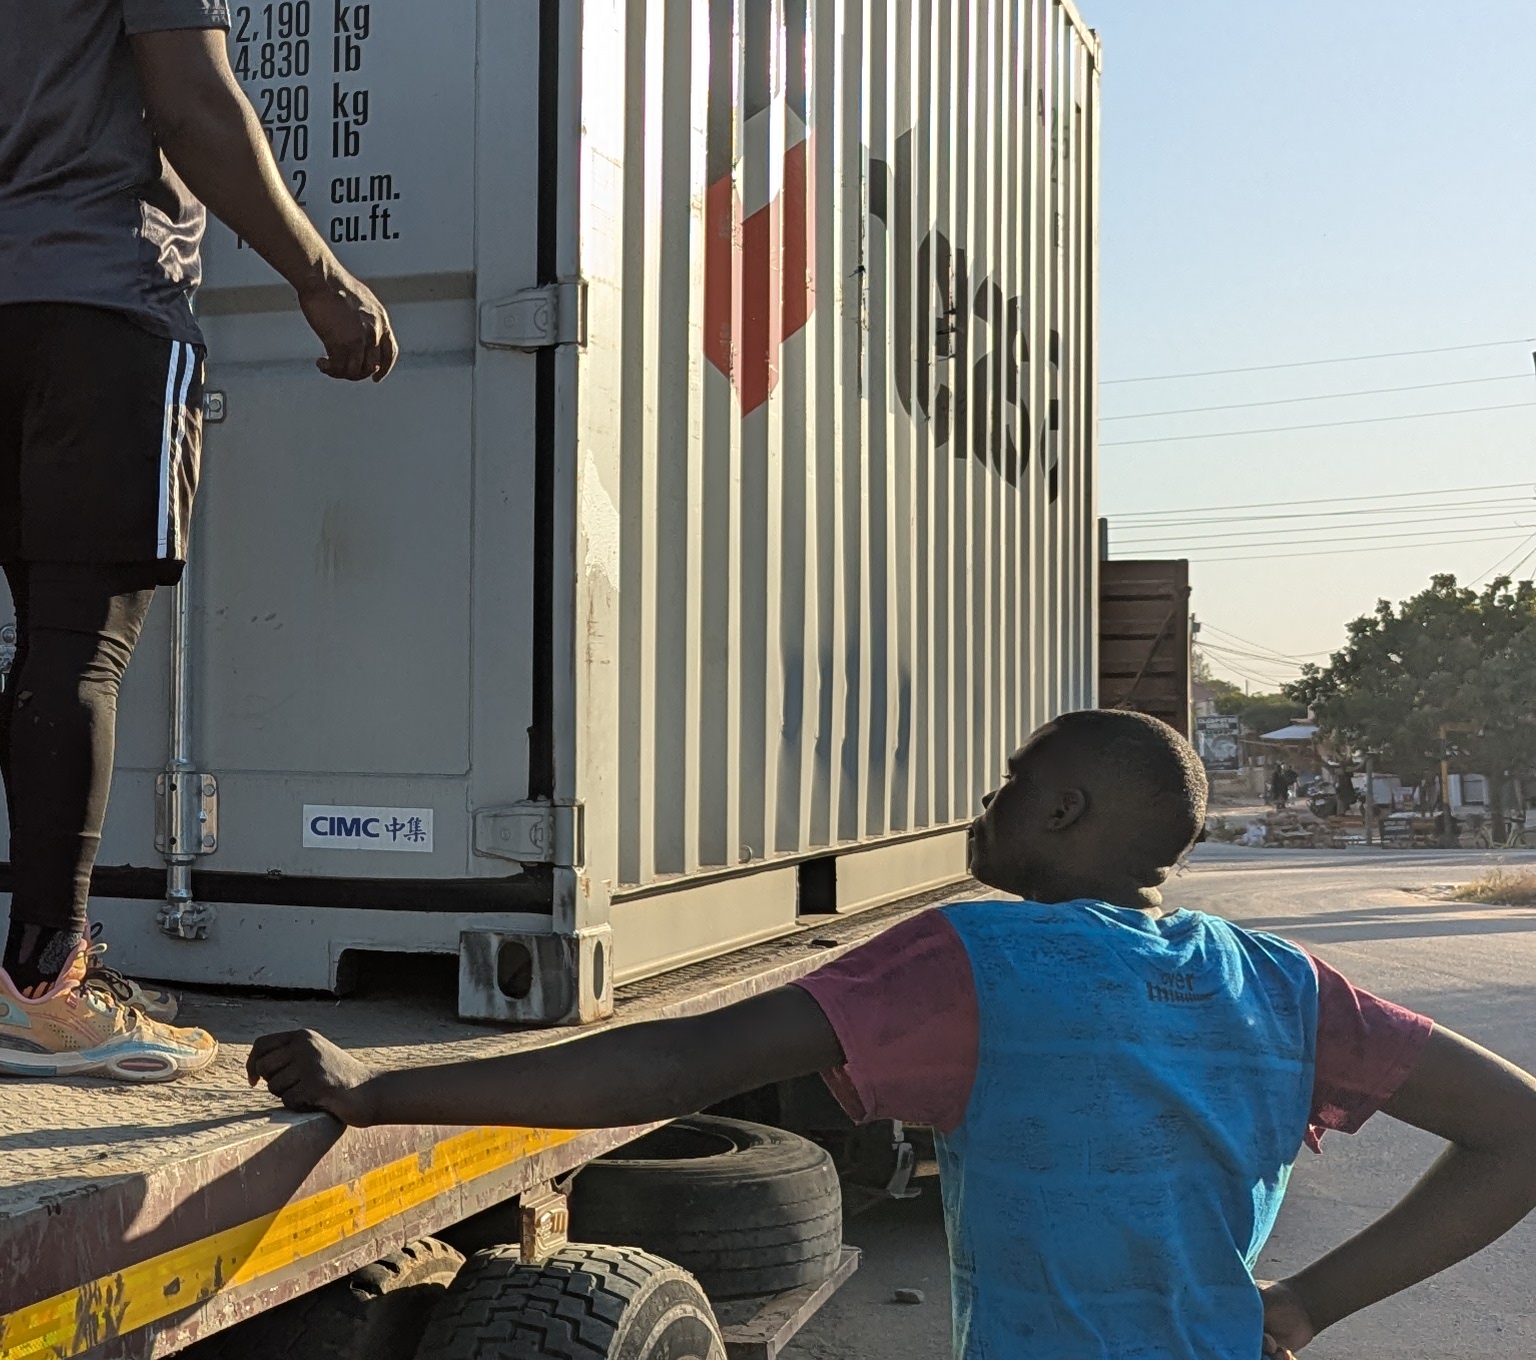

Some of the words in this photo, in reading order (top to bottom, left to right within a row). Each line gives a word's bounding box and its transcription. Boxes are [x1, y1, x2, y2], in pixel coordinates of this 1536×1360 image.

[236, 0, 310, 43] 2,190
[235, 39, 310, 80] 4,830
[333, 35, 361, 73] lb
[333, 82, 369, 126] kg
[332, 121, 360, 158] lb
[331, 175, 401, 204] cu.m.
[330, 204, 400, 243] cu.ft.
[310, 816, 380, 838] CIMC
[384, 816, 427, 842] 中集
